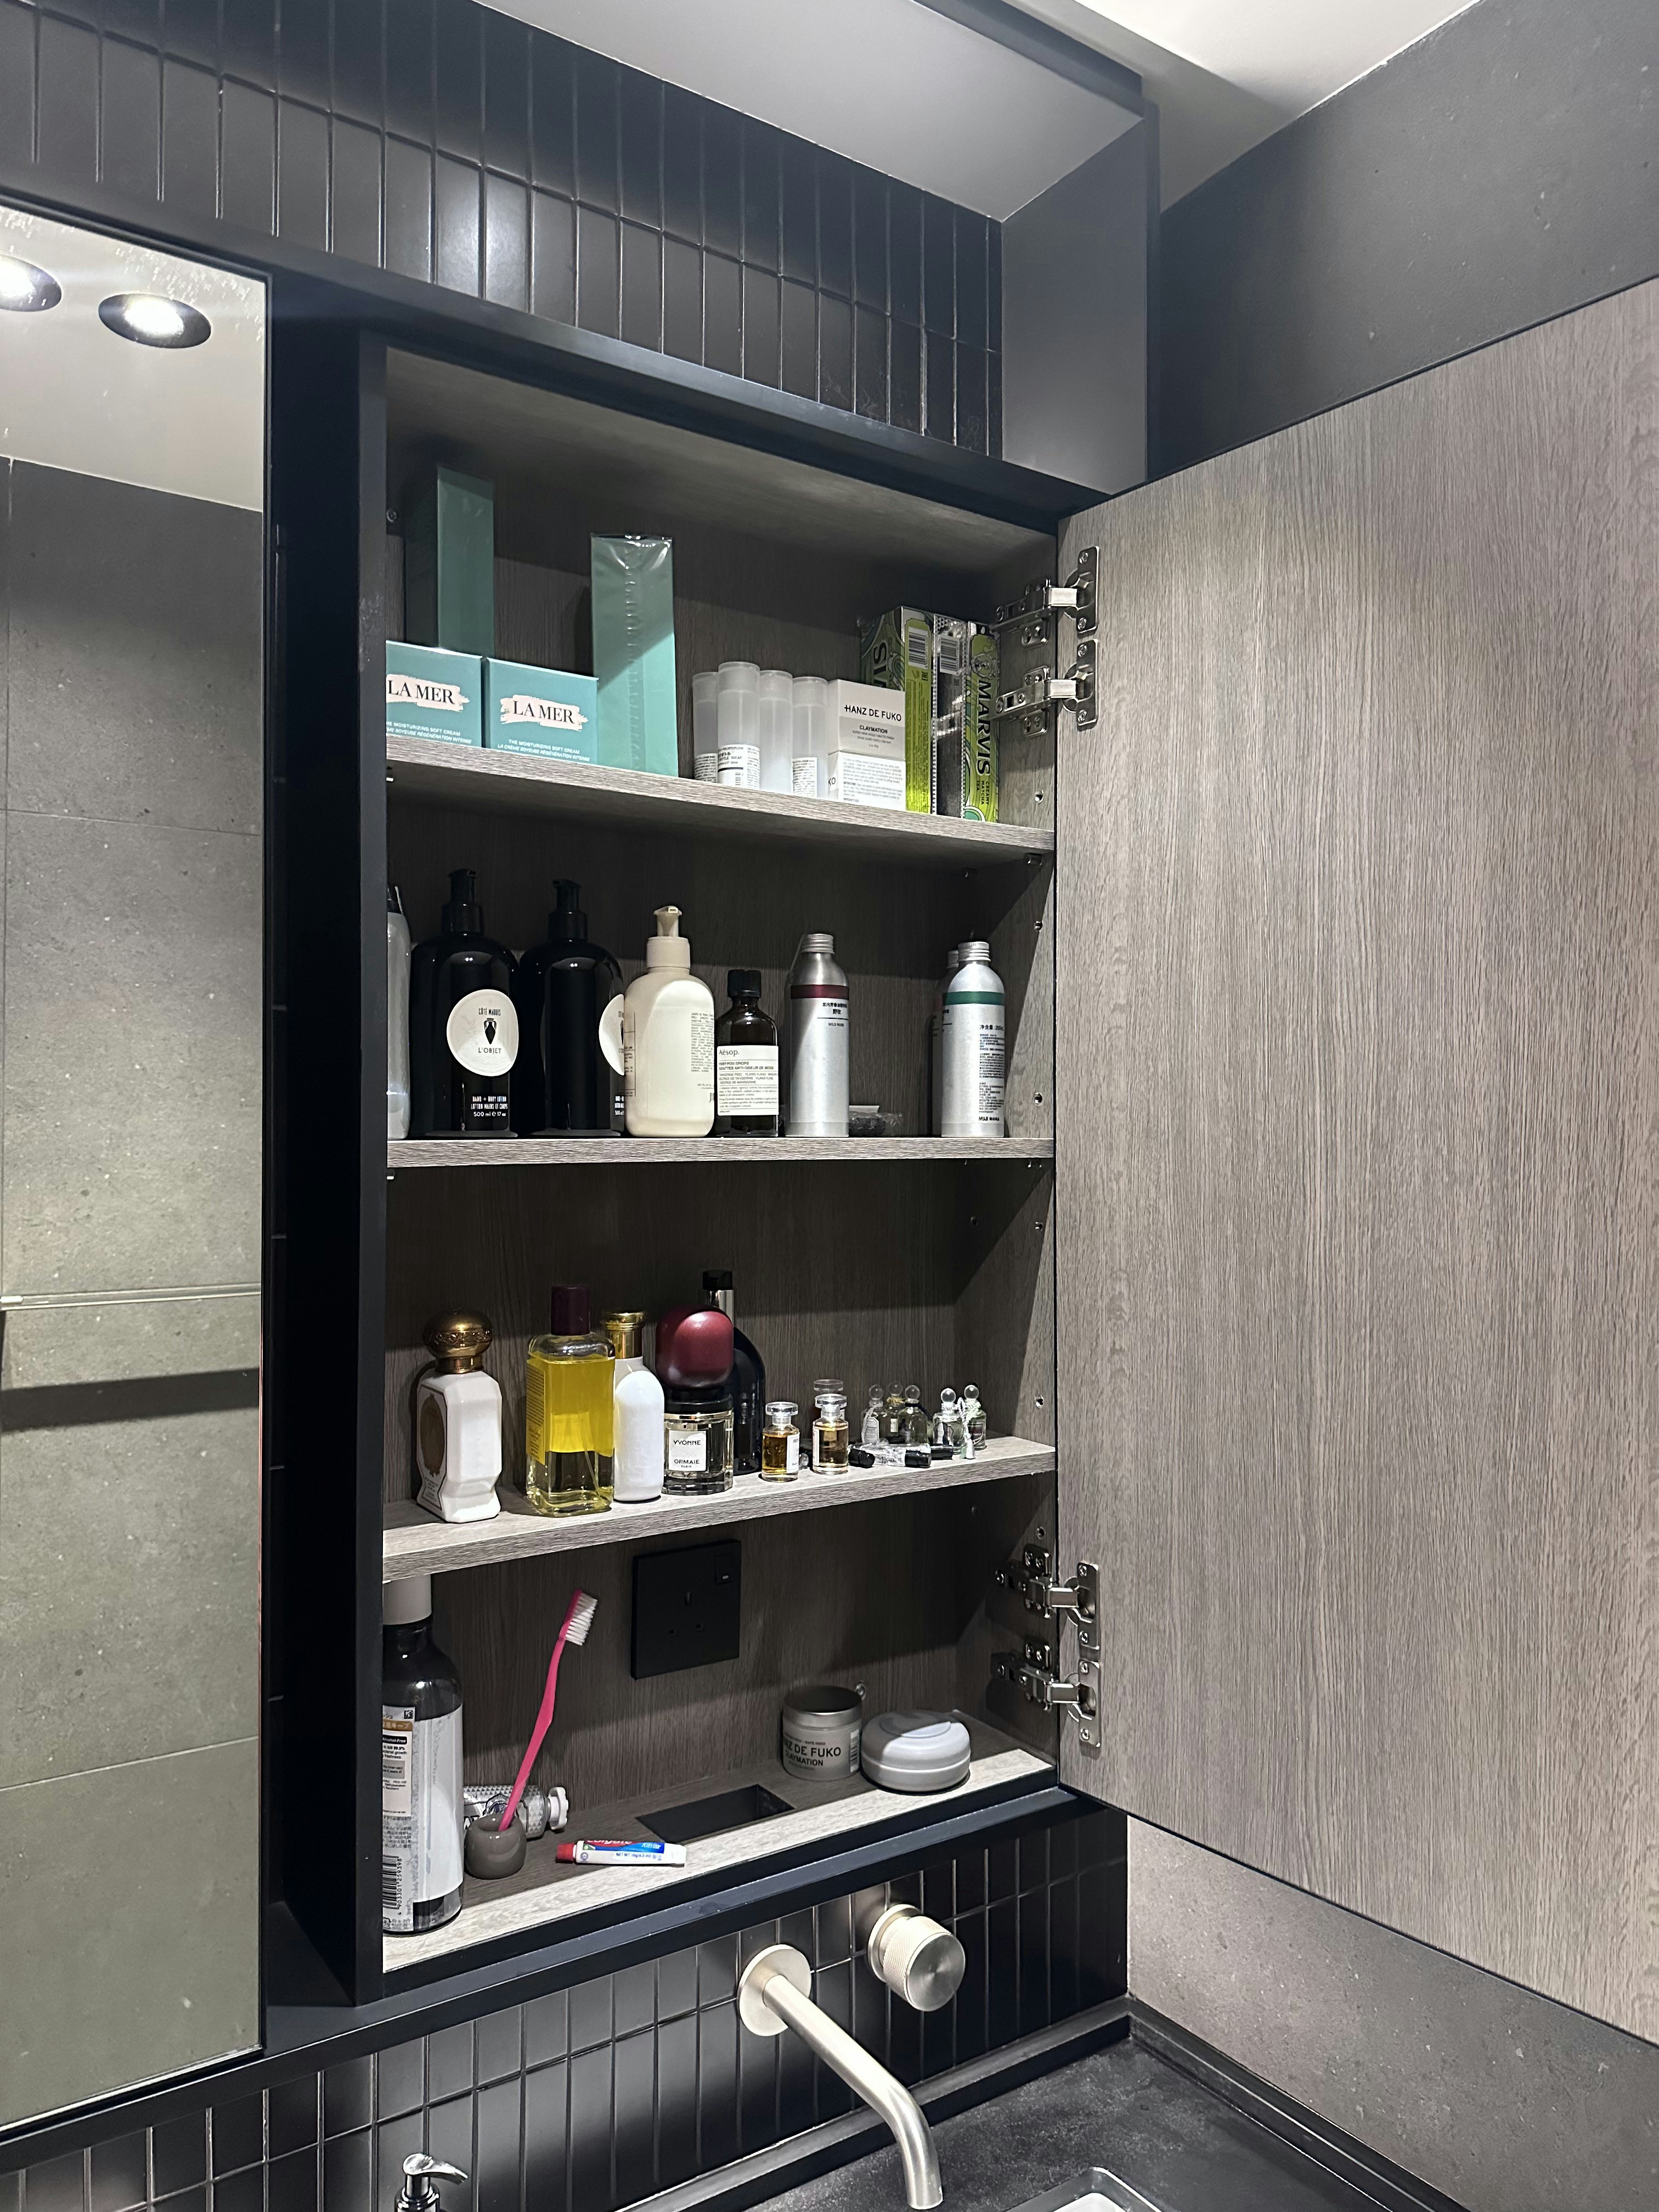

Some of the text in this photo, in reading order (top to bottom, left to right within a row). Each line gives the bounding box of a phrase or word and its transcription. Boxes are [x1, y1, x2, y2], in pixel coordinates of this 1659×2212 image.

[387, 680, 455, 704] LA MER
[513, 700, 575, 724] LA MER
[844, 704, 902, 721] HANZ DE FUKO
[394, 723, 429, 731] MOISTURIZING
[859, 725, 888, 734] CLAYMATION
[977, 679, 992, 776] MARVIS
[518, 741, 551, 750] MOISTURIZING
[794, 1743, 807, 1756] DE
[811, 1747, 841, 1757] FUKO
